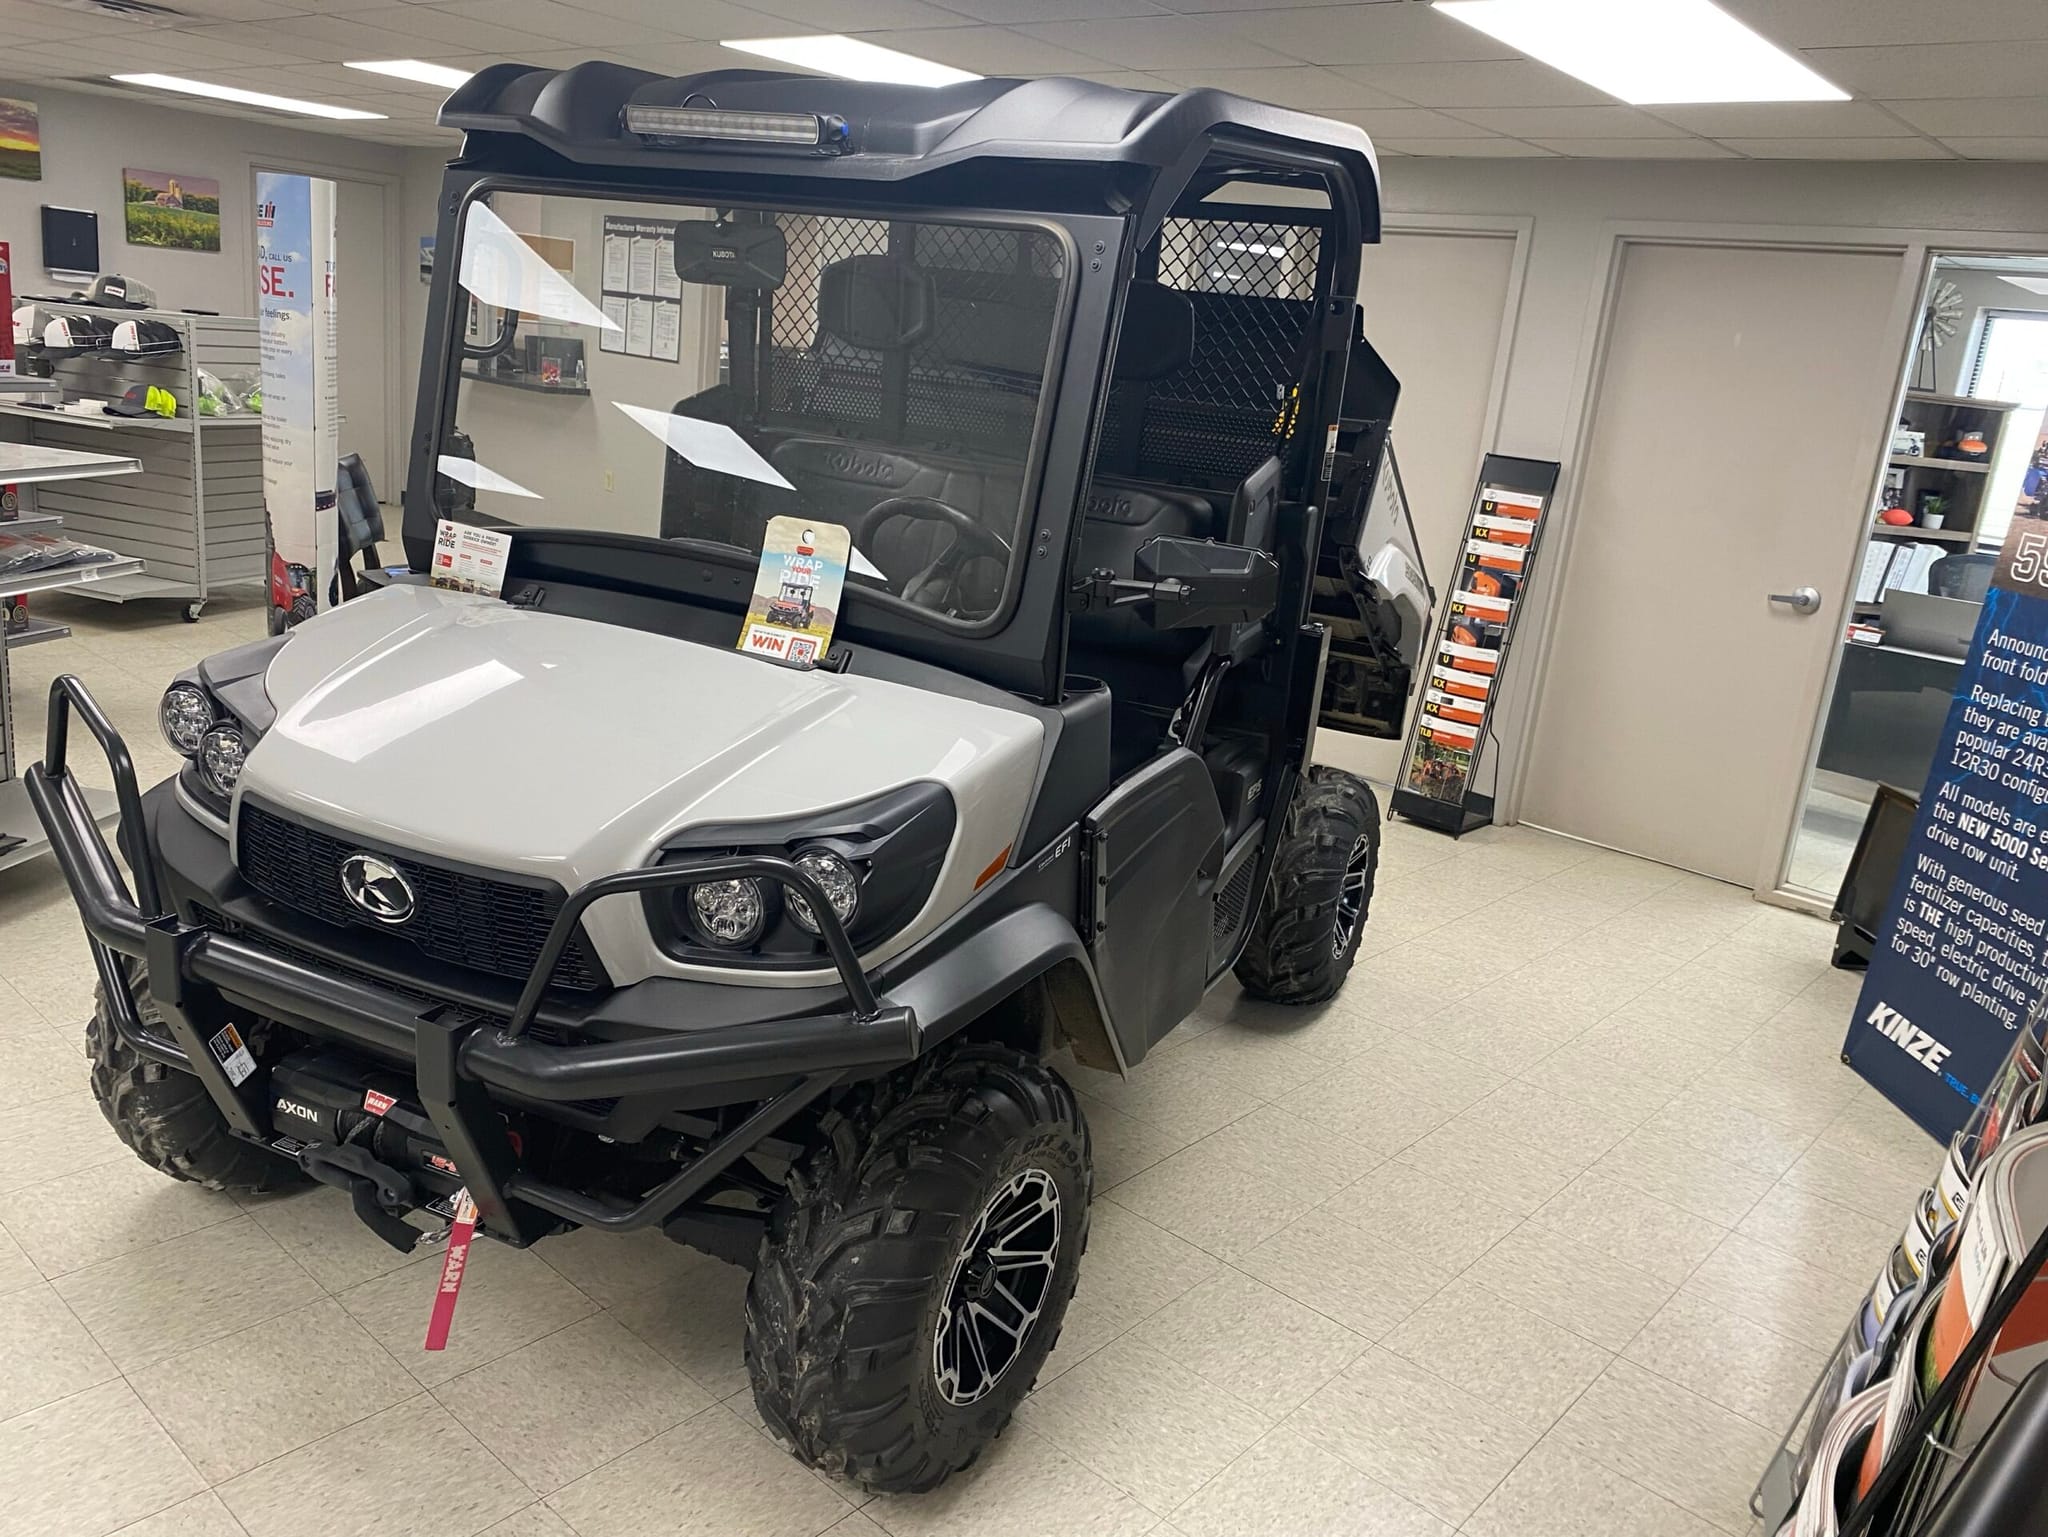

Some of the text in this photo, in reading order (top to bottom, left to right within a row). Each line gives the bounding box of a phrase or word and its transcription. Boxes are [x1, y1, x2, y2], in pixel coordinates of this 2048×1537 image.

[636, 225, 656, 234] Warranty
[283, 254, 293, 262] US
[1485, 502, 1494, 511] U
[438, 537, 456, 548] RIDE
[440, 530, 457, 538] WRAP
[1475, 528, 1489, 538] KX
[783, 555, 824, 571] WRAP
[1469, 554, 1476, 563] U
[1452, 603, 1465, 614] KX
[752, 634, 785, 652] WIN
[1443, 655, 1450, 663] U
[1981, 650, 2017, 676] front
[1433, 679, 1446, 688] KX
[1426, 703, 1438, 713] KX
[1970, 684, 2043, 727] Replacing
[1419, 727, 1432, 738] TLB
[1964, 706, 1996, 733] they
[1996, 722, 2020, 740] are
[1956, 731, 2012, 760] popular
[1950, 748, 2000, 781] 12R30
[1939, 781, 1960, 802] All
[1961, 794, 2012, 826] models
[2013, 818, 2037, 838] are
[1933, 802, 1956, 824] the
[1958, 813, 1991, 840] NEW
[1990, 827, 2029, 859] 5000
[1055, 836, 1071, 858] EFI
[1926, 824, 2020, 883] drive row unit.
[1917, 853, 2046, 937] With generous seed
[1904, 893, 1916, 913] is
[1919, 902, 1945, 929] THE
[1945, 918, 1974, 947] high
[1910, 874, 2037, 963] fertilizer capacities,
[1897, 917, 2026, 1006] speed, electric drive
[1891, 934, 1911, 956] for
[1911, 947, 1937, 969] 30"
[1936, 965, 1961, 988] row
[1960, 982, 2019, 1030] planting.
[1866, 1001, 1953, 1074] KINZE
[276, 1098, 318, 1123] AXON
[441, 1244, 467, 1293] WARN
